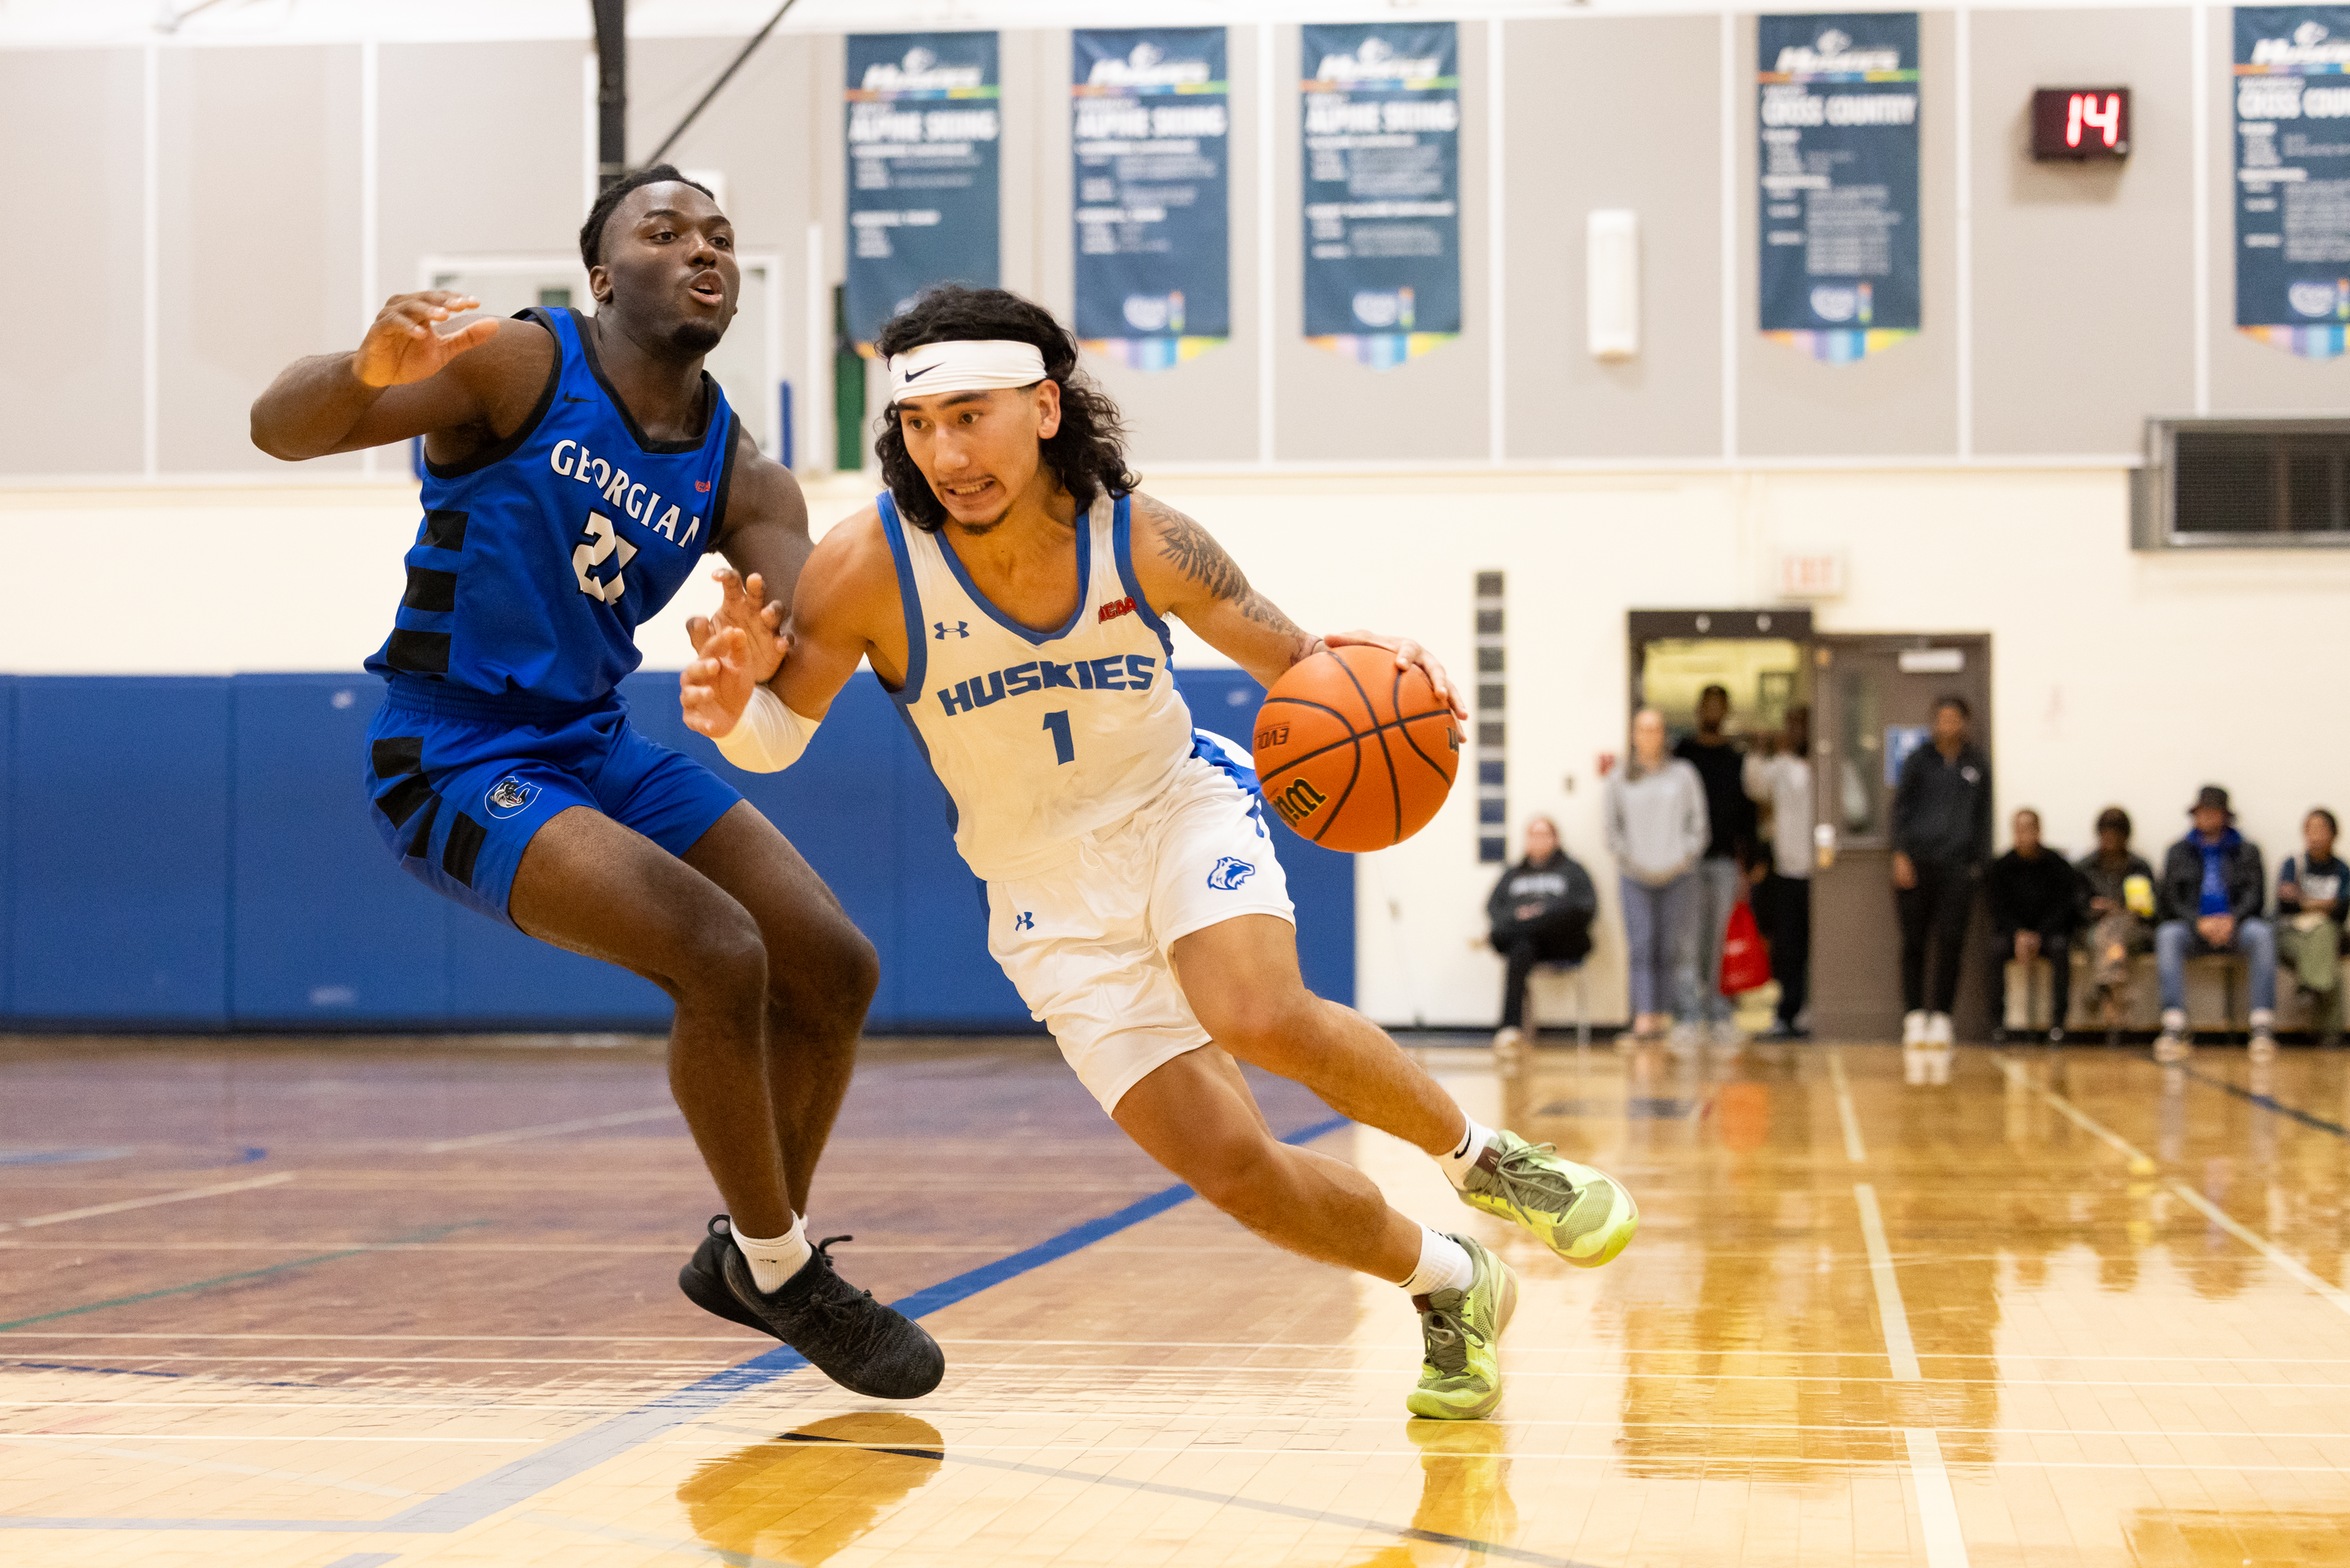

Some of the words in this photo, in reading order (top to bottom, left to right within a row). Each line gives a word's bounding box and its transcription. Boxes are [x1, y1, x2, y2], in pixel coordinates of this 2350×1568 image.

[2066, 93, 2121, 148] 14
[937, 654, 1156, 716] HUSKIES
[1042, 709, 1075, 766] 1
